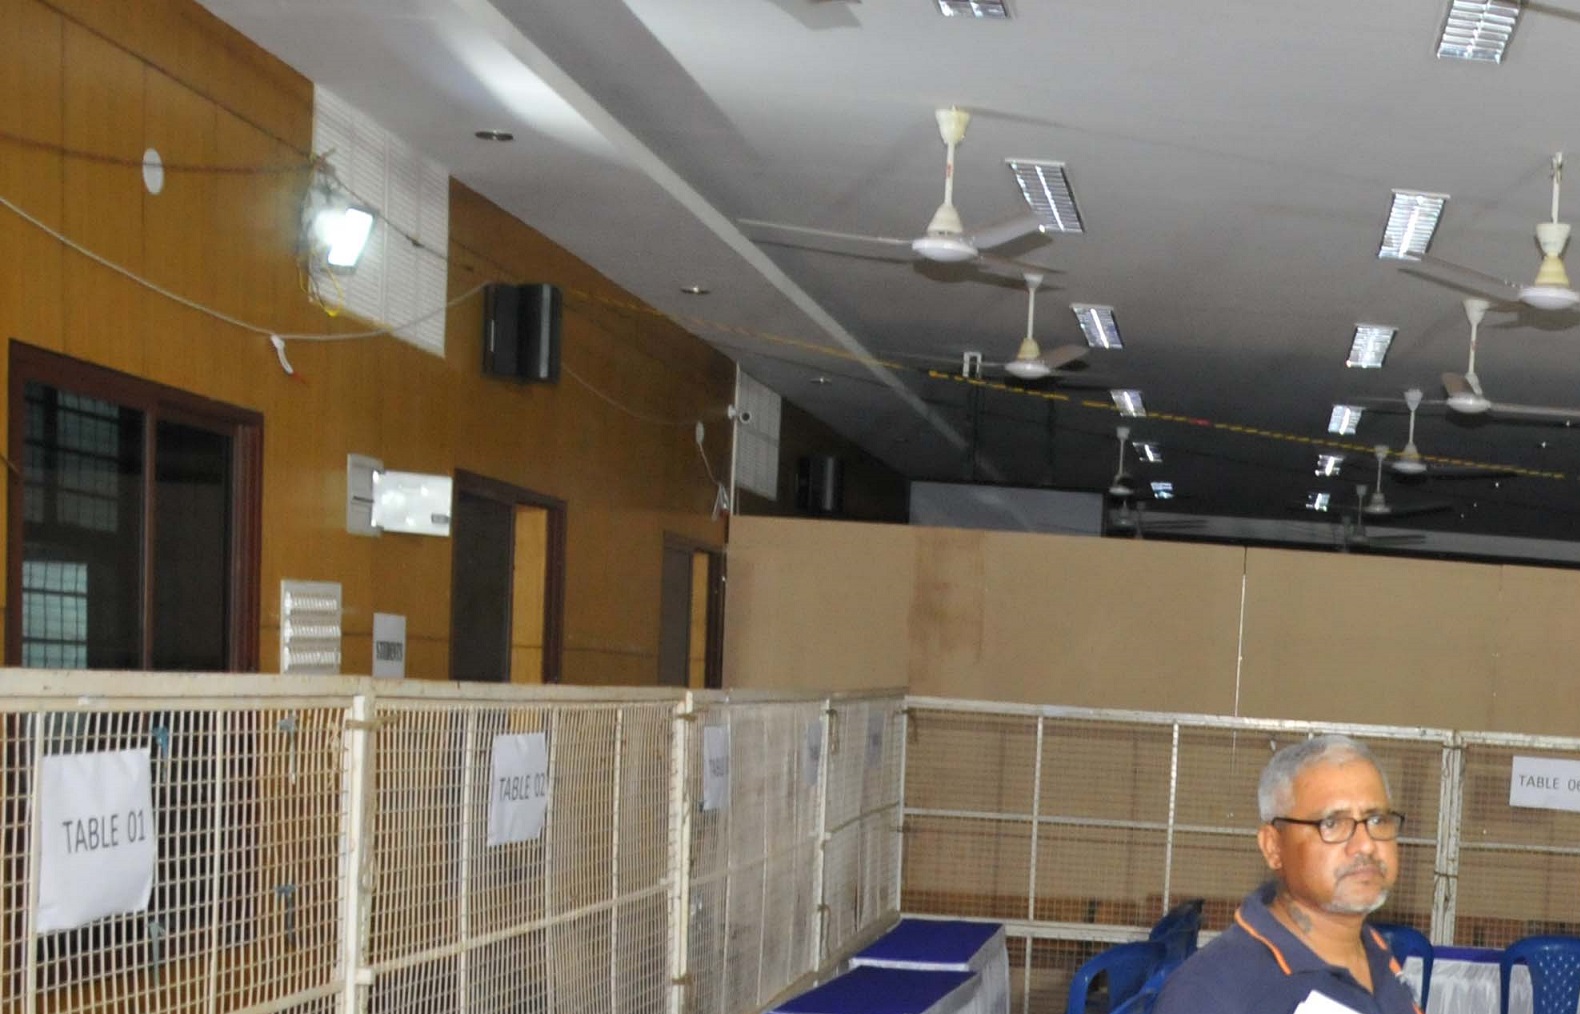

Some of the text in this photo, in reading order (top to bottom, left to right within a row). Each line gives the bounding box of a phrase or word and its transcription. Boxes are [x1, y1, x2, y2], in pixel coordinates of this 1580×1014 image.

[499, 772, 545, 801] TABLE 02
[1519, 774, 1560, 790] TABLE
[62, 809, 147, 854] TABLE 01
